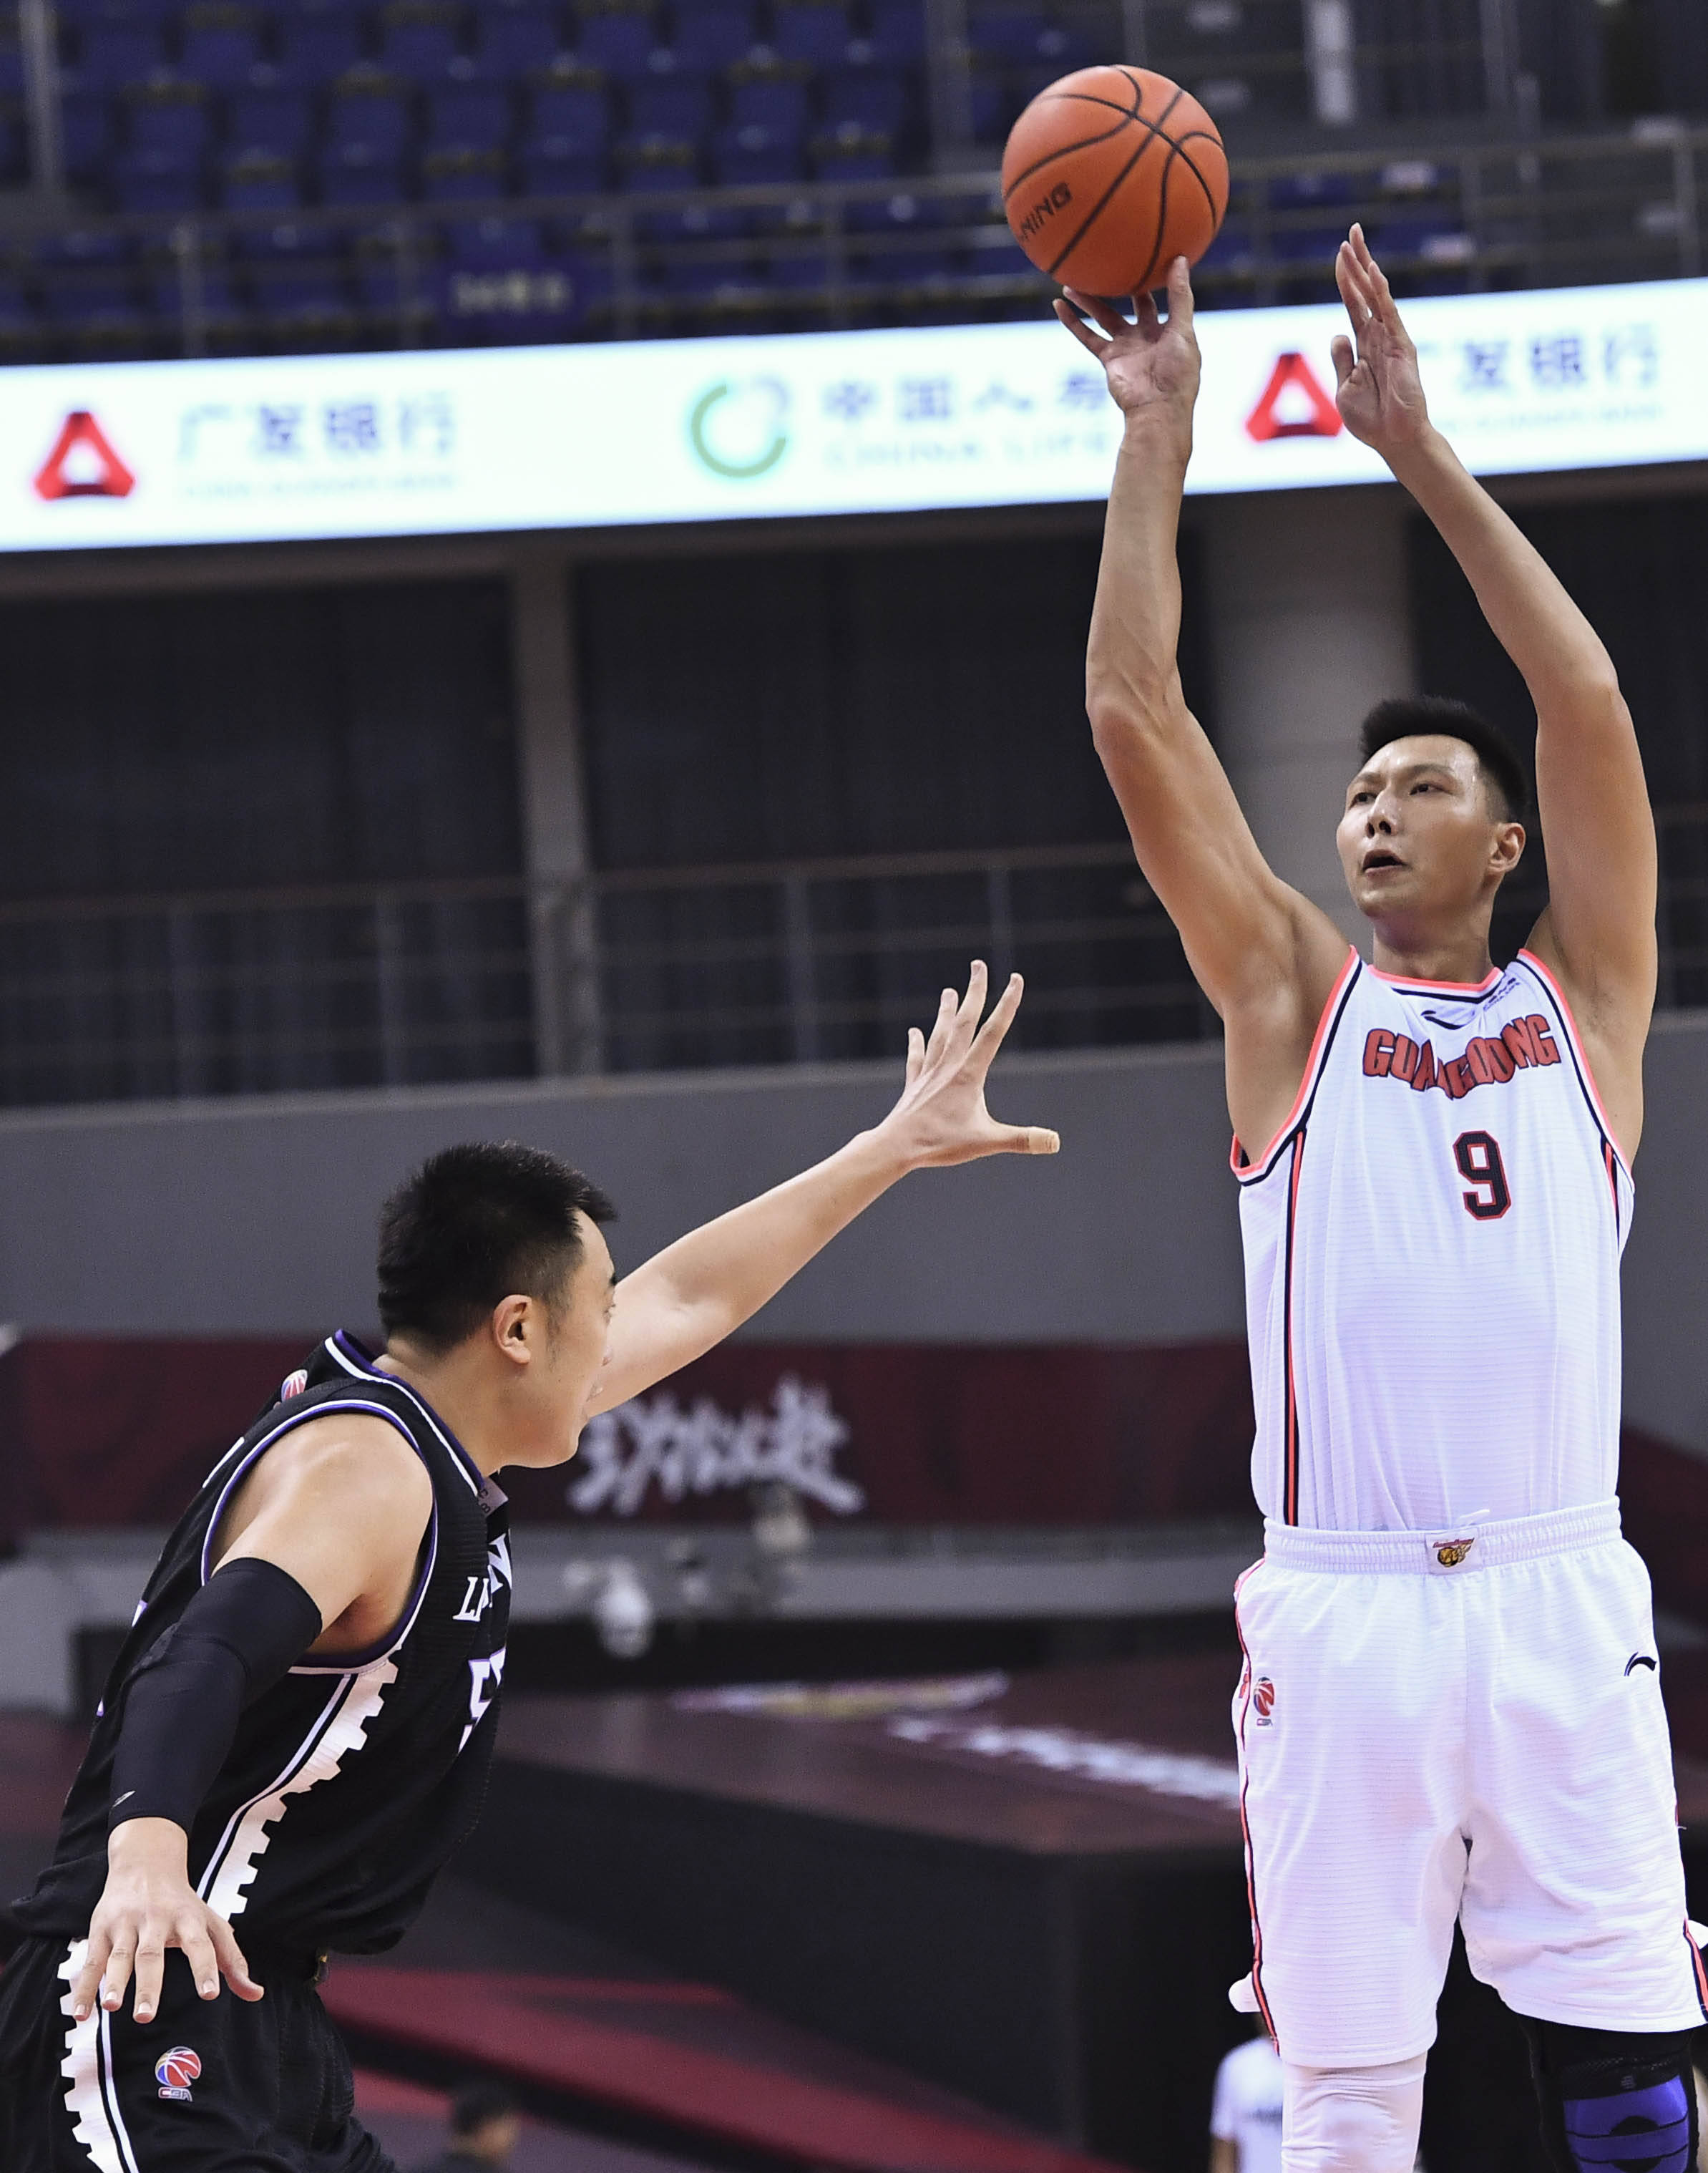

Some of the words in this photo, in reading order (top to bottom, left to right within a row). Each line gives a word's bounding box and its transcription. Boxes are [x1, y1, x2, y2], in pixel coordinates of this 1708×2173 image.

[1417, 325, 1657, 394] 发银行
[177, 393, 456, 463] 广发银行
[1452, 1130, 1512, 1220] 9
